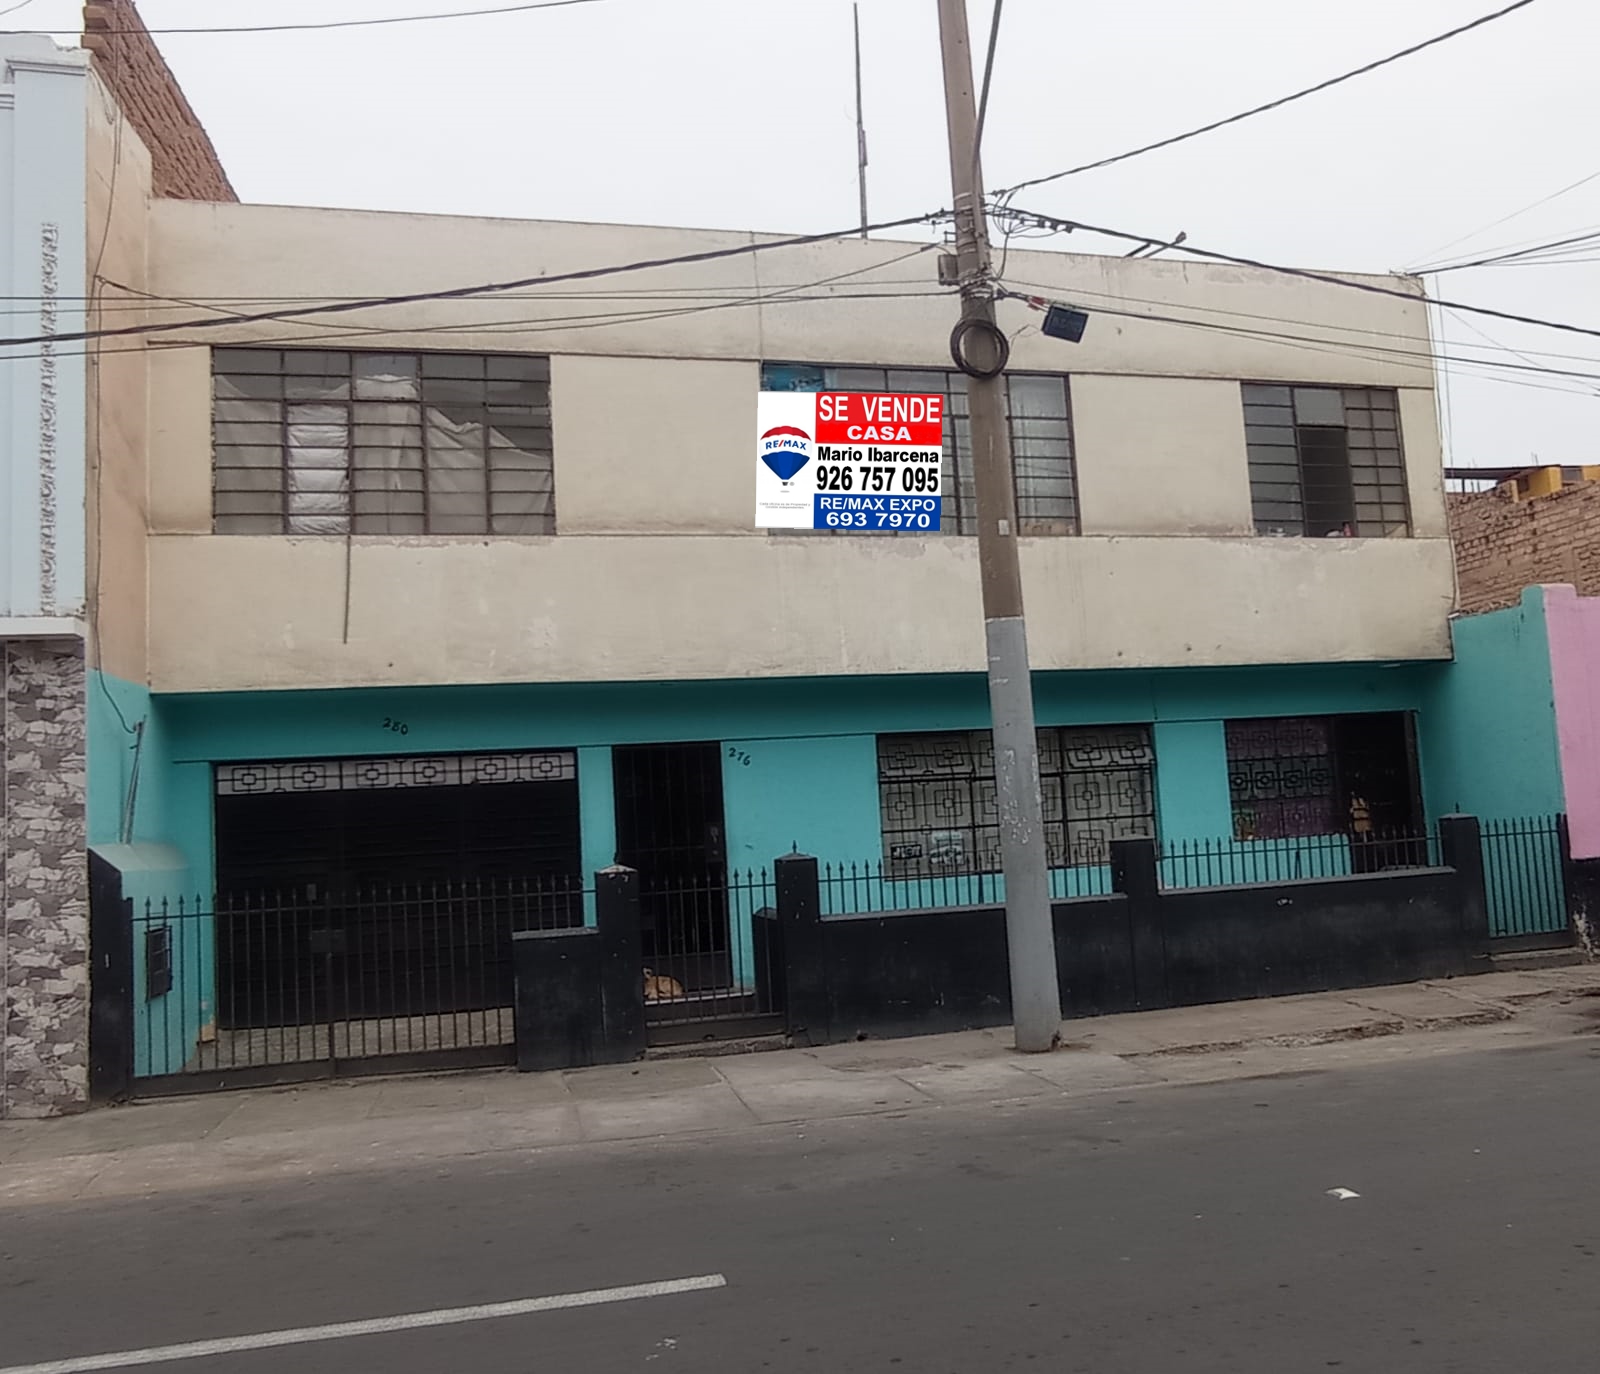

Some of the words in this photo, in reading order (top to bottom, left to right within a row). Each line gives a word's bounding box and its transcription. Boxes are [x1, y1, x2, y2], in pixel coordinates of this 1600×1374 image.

[819, 395, 848, 421] SE
[862, 396, 940, 423] VENDE
[847, 426, 912, 441] CASA
[765, 440, 806, 451] RE/MAX
[818, 446, 862, 462] Mario
[868, 447, 939, 463] Ibarcena
[816, 465, 853, 491] 926
[859, 466, 896, 491] 757
[902, 467, 938, 492] 095
[820, 497, 885, 511] RE/MAX
[890, 499, 936, 511] EXPO
[826, 512, 867, 527] 693
[875, 513, 931, 528] 7970
[382, 717, 408, 735] 280
[728, 747, 751, 766] 276
